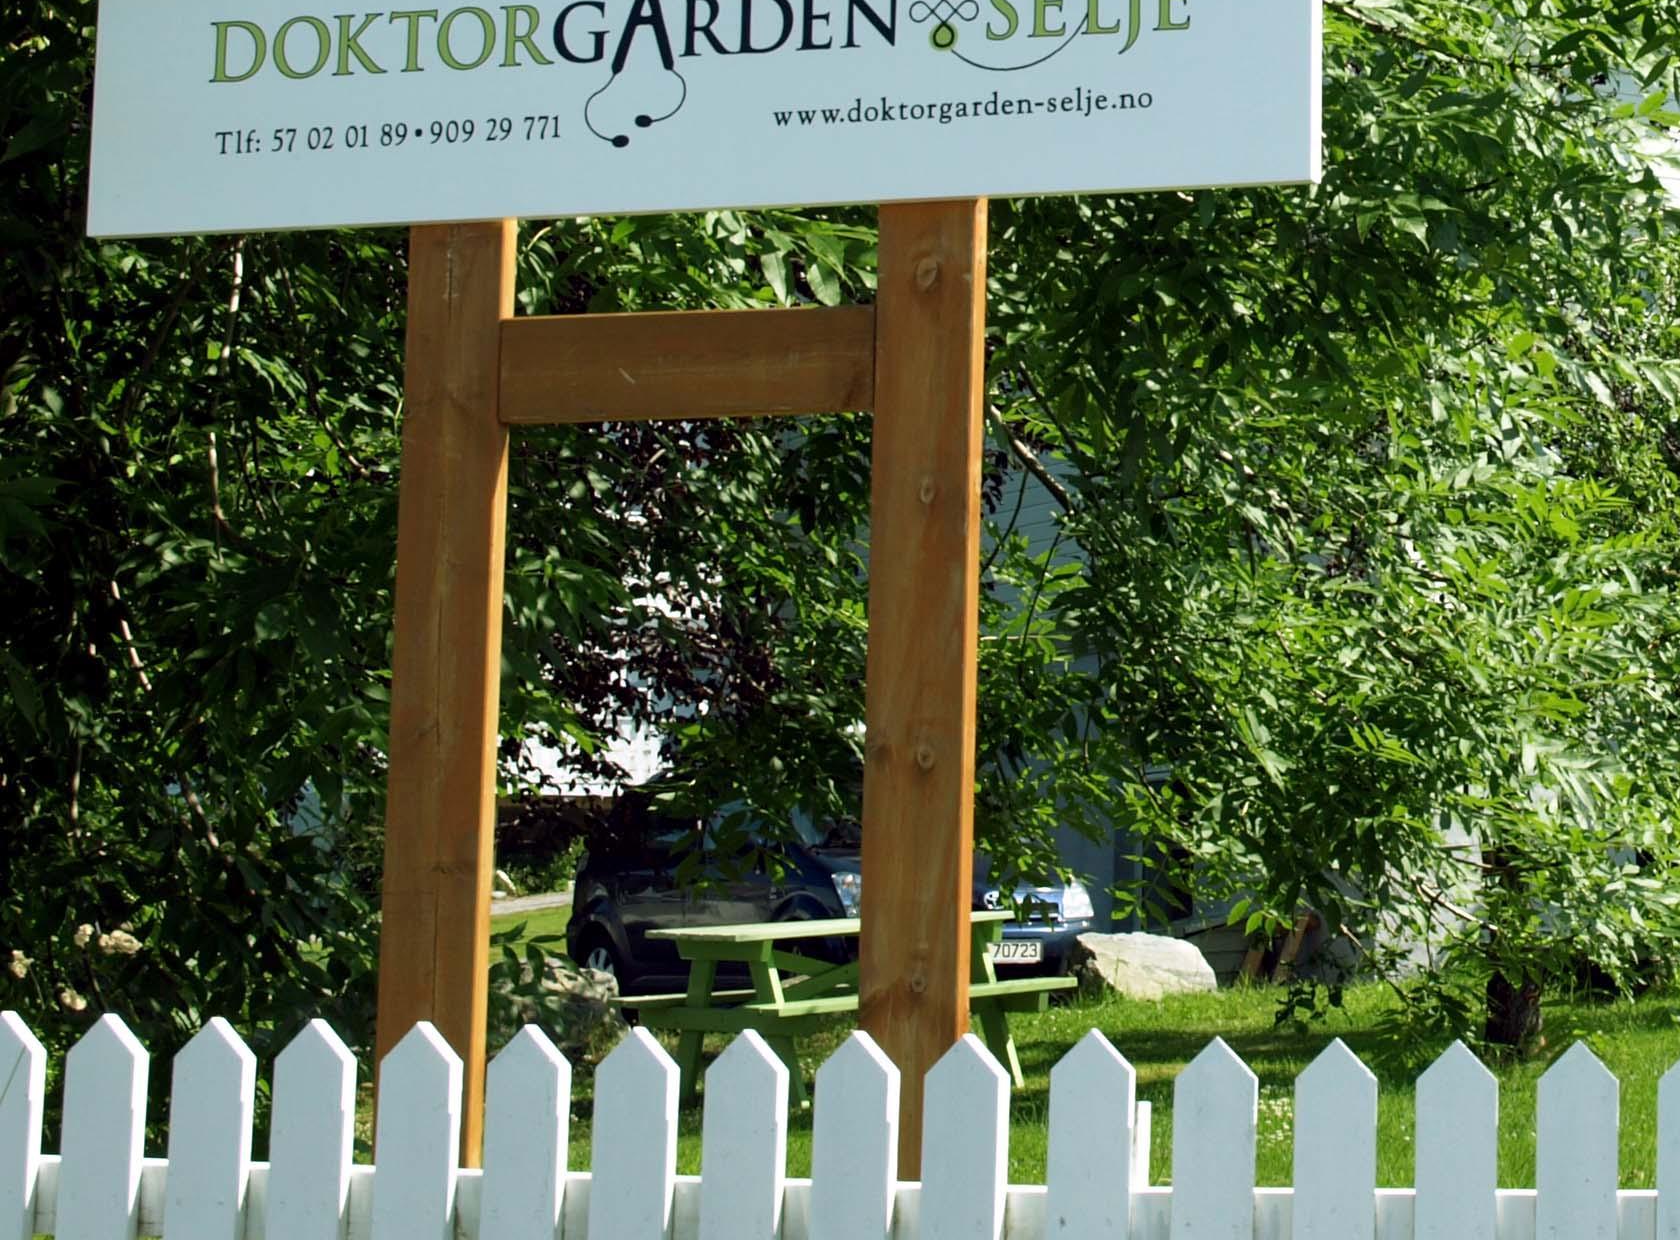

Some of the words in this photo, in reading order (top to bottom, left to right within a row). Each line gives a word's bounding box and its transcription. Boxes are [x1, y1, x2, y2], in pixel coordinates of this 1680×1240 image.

[773, 88, 1153, 128] www.doktorgarden-selje.no
[215, 127, 262, 155] Tlf:
[272, 128, 297, 152] 57
[307, 127, 334, 150] 02
[345, 125, 369, 148] 01
[381, 123, 408, 147] 89
[430, 120, 475, 144] 909
[486, 117, 513, 141] 29
[523, 116, 561, 140] 771
[993, 943, 1038, 958] 70723
